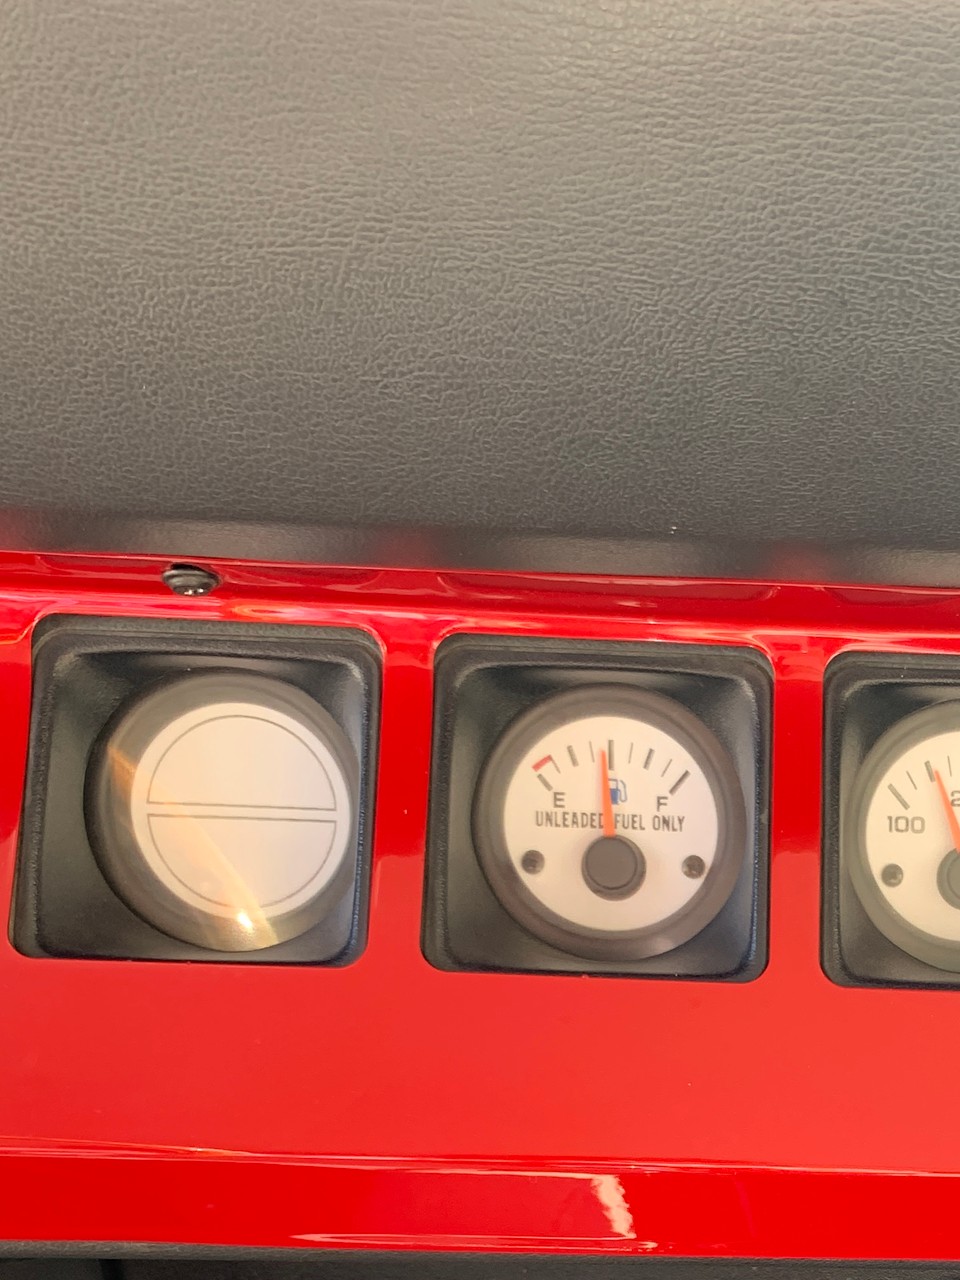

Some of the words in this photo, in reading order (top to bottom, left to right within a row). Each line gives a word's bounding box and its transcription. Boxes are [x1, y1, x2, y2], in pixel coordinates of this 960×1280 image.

[553, 791, 566, 808] E
[656, 796, 668, 812] F
[614, 814, 645, 831] FUEL
[652, 815, 685, 832] ONLY
[887, 816, 925, 834] 100
